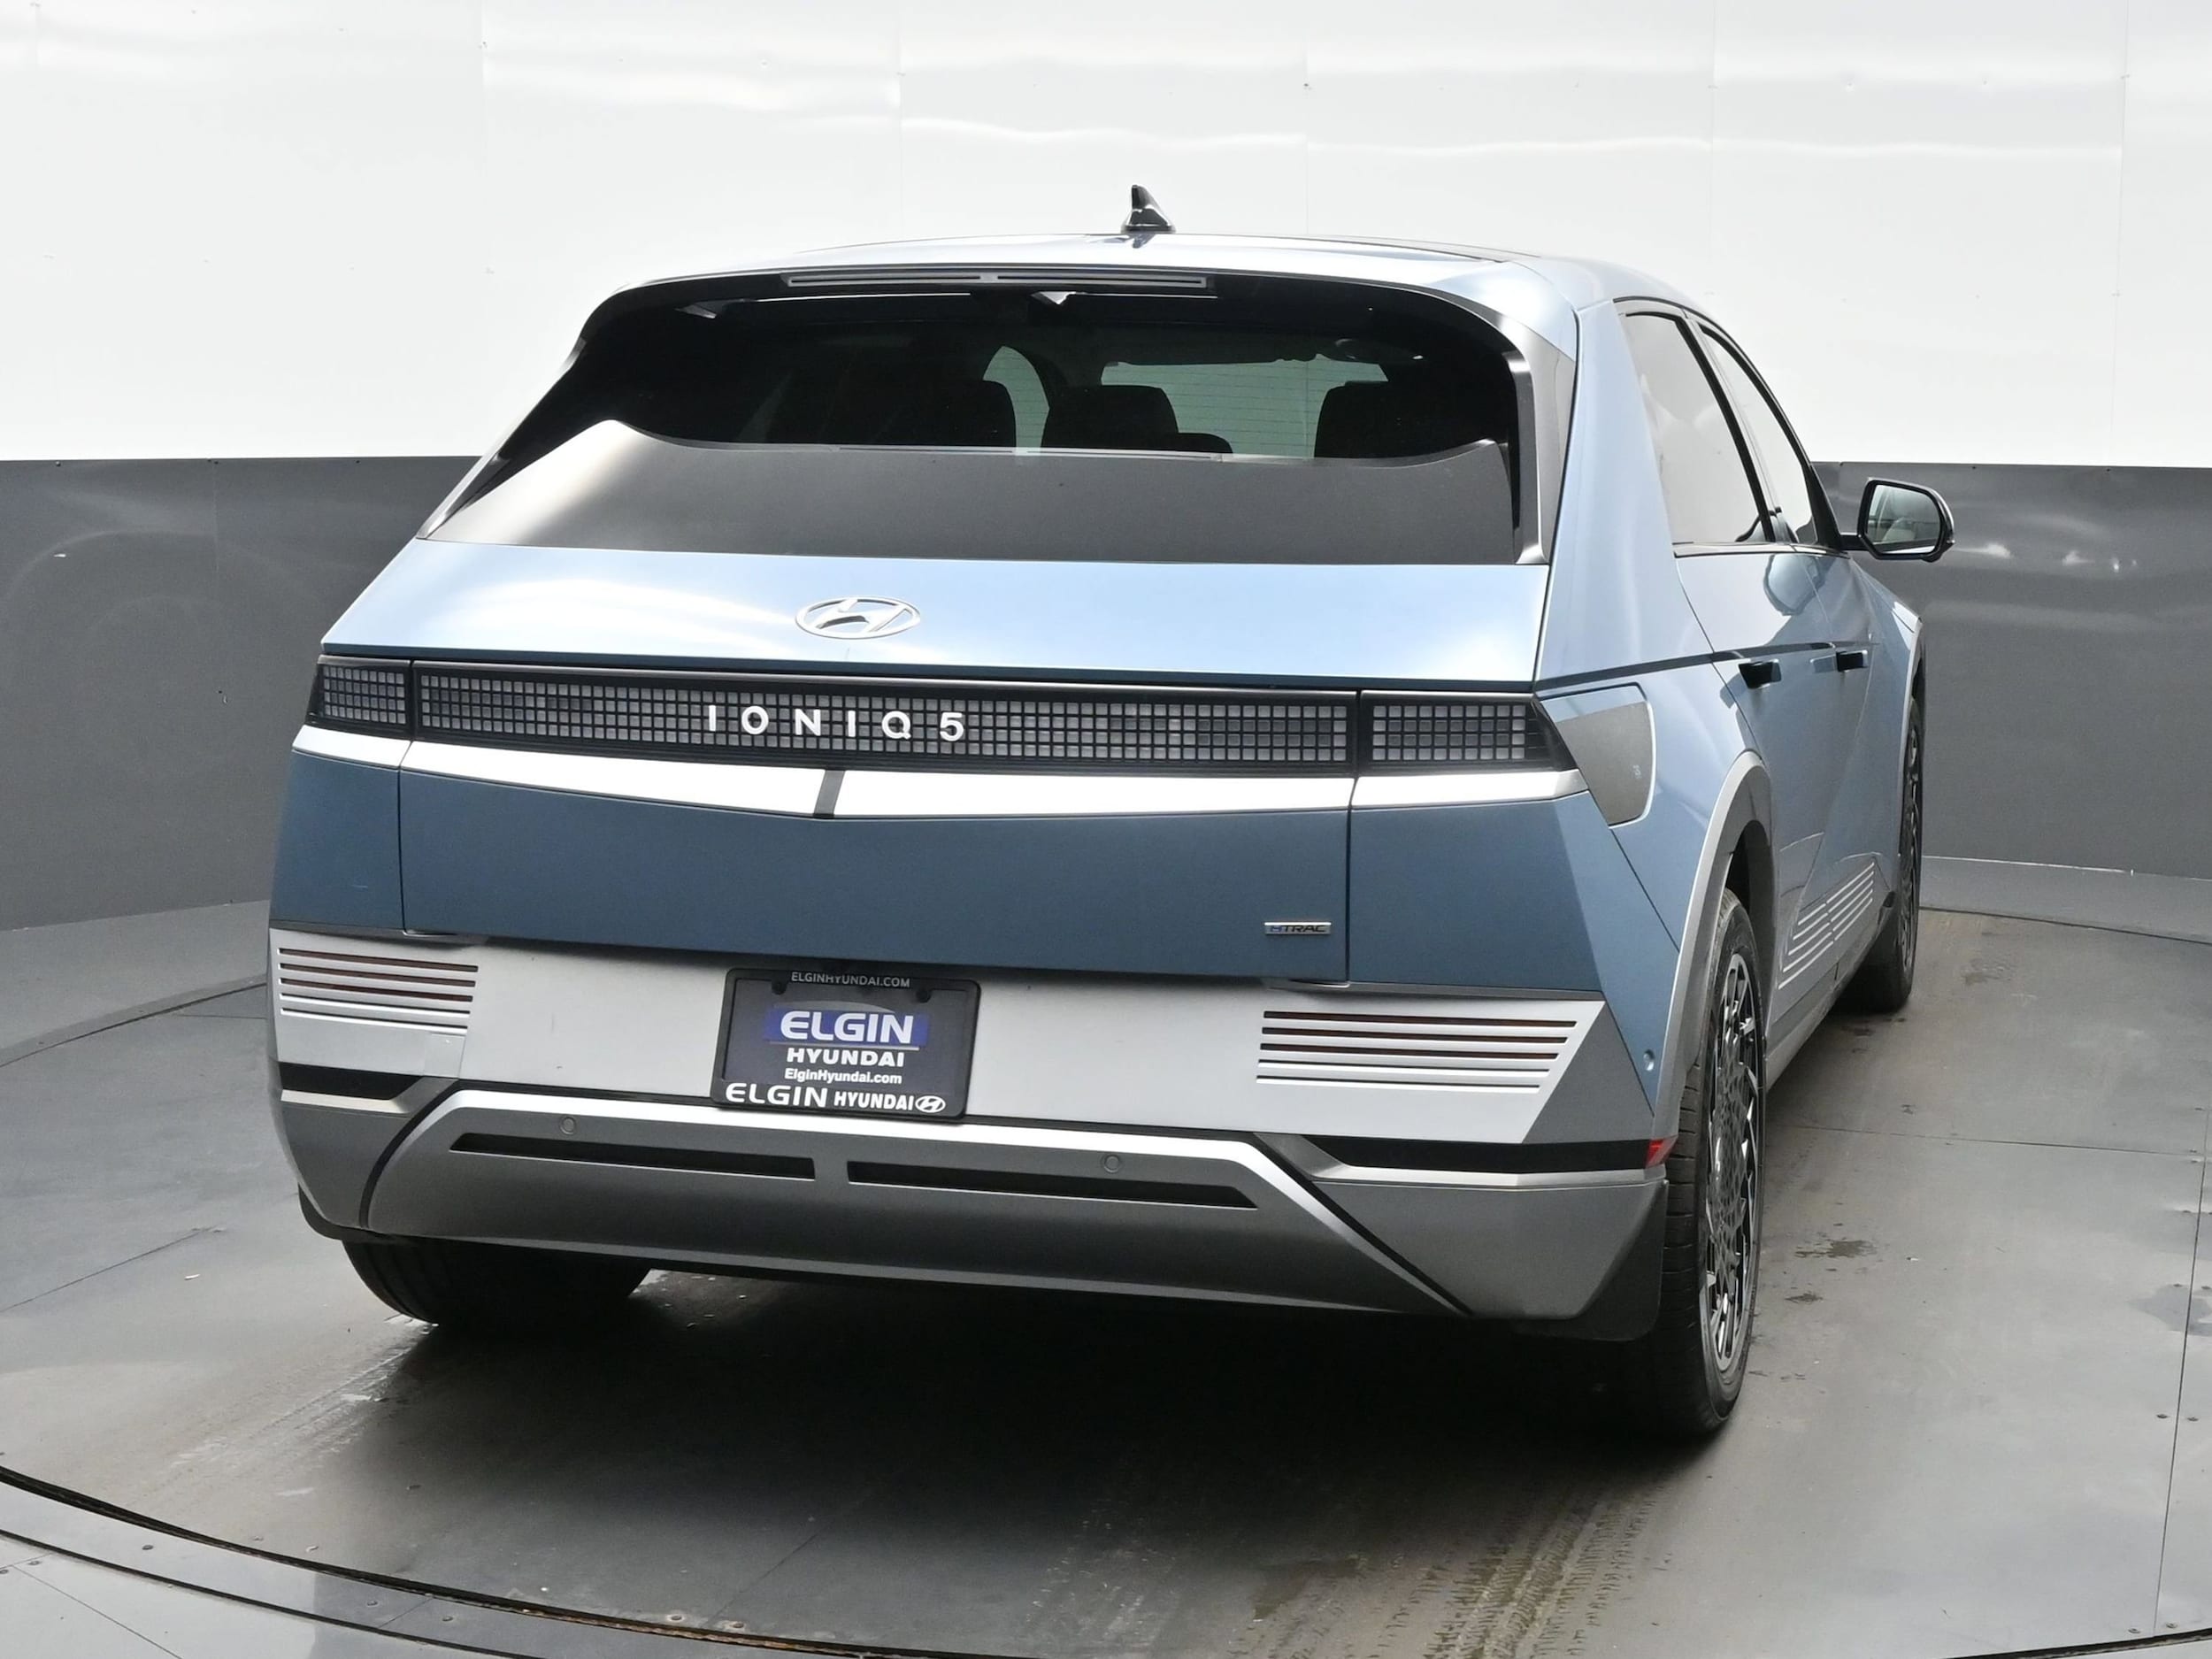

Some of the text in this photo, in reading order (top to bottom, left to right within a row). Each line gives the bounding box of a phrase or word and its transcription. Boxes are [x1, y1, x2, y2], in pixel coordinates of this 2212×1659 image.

[708, 704, 964, 741] IONIQ 5
[791, 972, 910, 987] ELGINHYUNDAI.COM
[780, 1010, 914, 1044] ELGIN
[787, 1048, 904, 1067] HYUNDAI
[785, 1068, 902, 1084] ElginHyundai.com
[725, 1082, 913, 1110] ELGIN HYUNDAI
